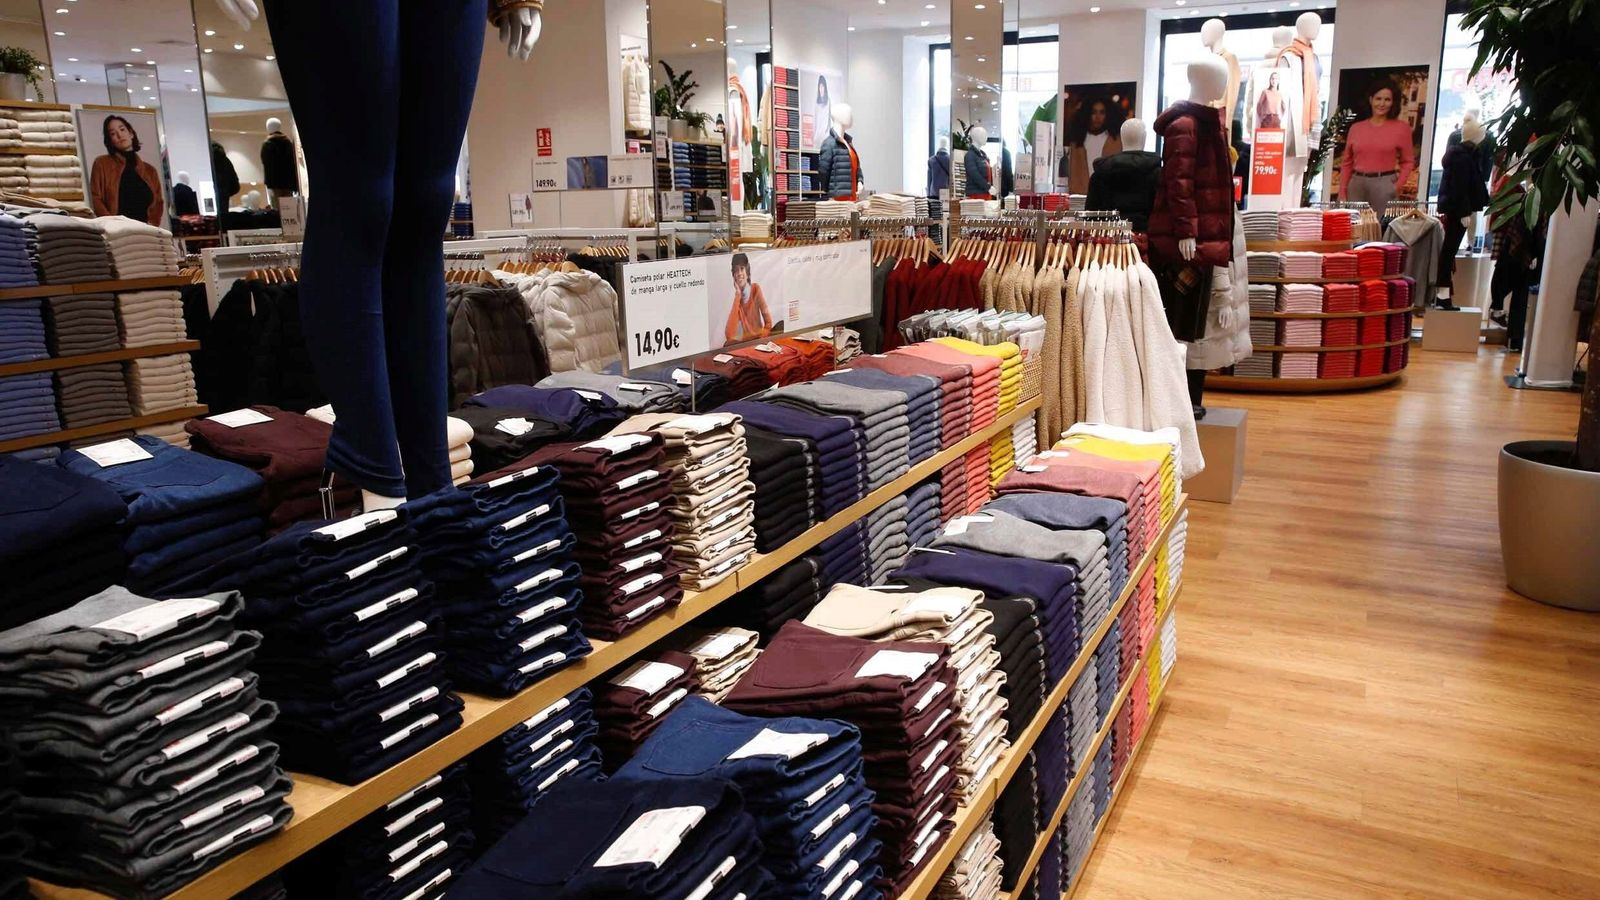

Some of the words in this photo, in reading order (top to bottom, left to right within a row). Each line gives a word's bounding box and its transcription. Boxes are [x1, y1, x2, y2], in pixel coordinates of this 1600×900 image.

[630, 274, 652, 284] Camiseta
[653, 273, 665, 283] polar
[666, 269, 692, 279] HEATTECH
[631, 287, 637, 295] de
[638, 286, 655, 295] manga
[656, 284, 668, 292] larga
[673, 281, 687, 289] cuello
[687, 279, 705, 287] redondo
[634, 327, 680, 357] 14,90€
